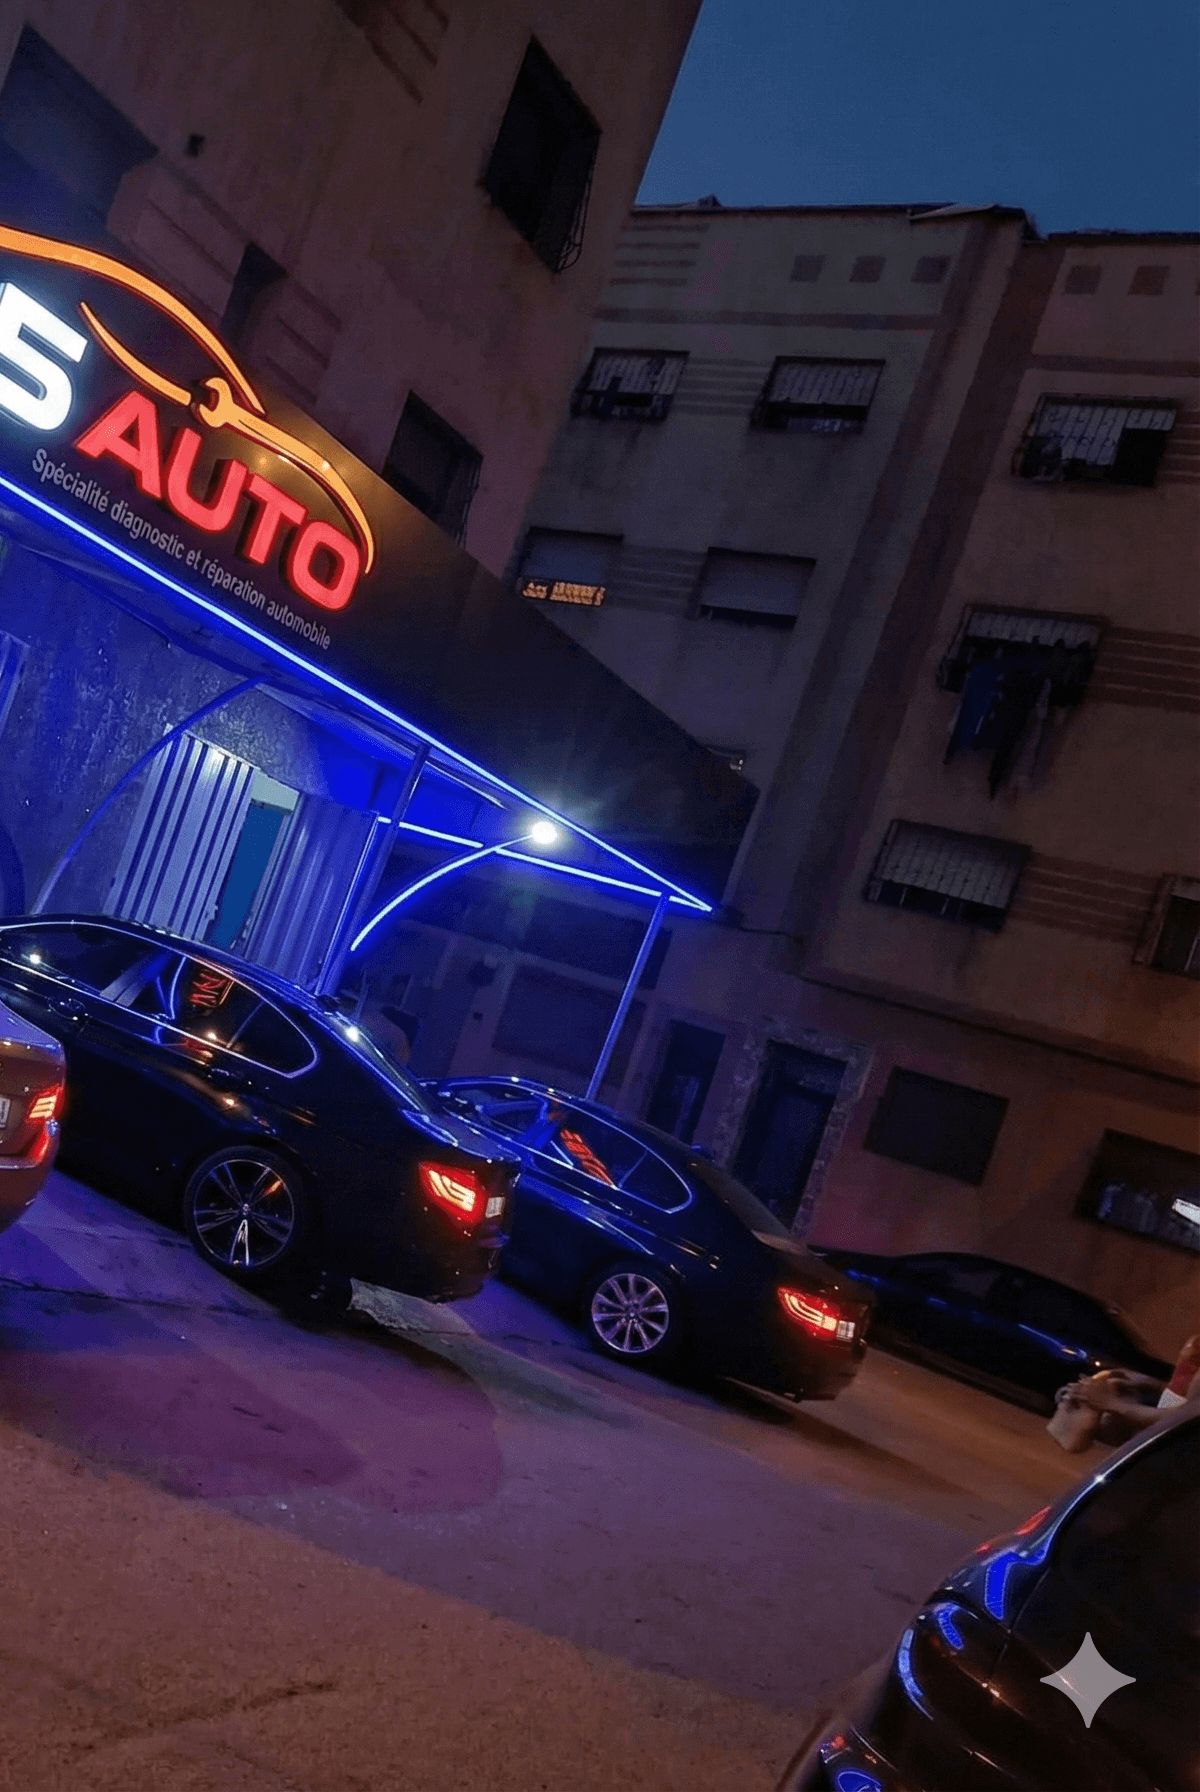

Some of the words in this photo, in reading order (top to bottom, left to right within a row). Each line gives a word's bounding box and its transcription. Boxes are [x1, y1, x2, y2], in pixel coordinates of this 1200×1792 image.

[32, 448, 110, 513] Spécialité
[110, 500, 185, 560] diagnostic
[186, 549, 202, 571] et
[201, 558, 266, 610] réparation
[266, 600, 331, 650] automobile
[75, 390, 360, 611] AUTO
